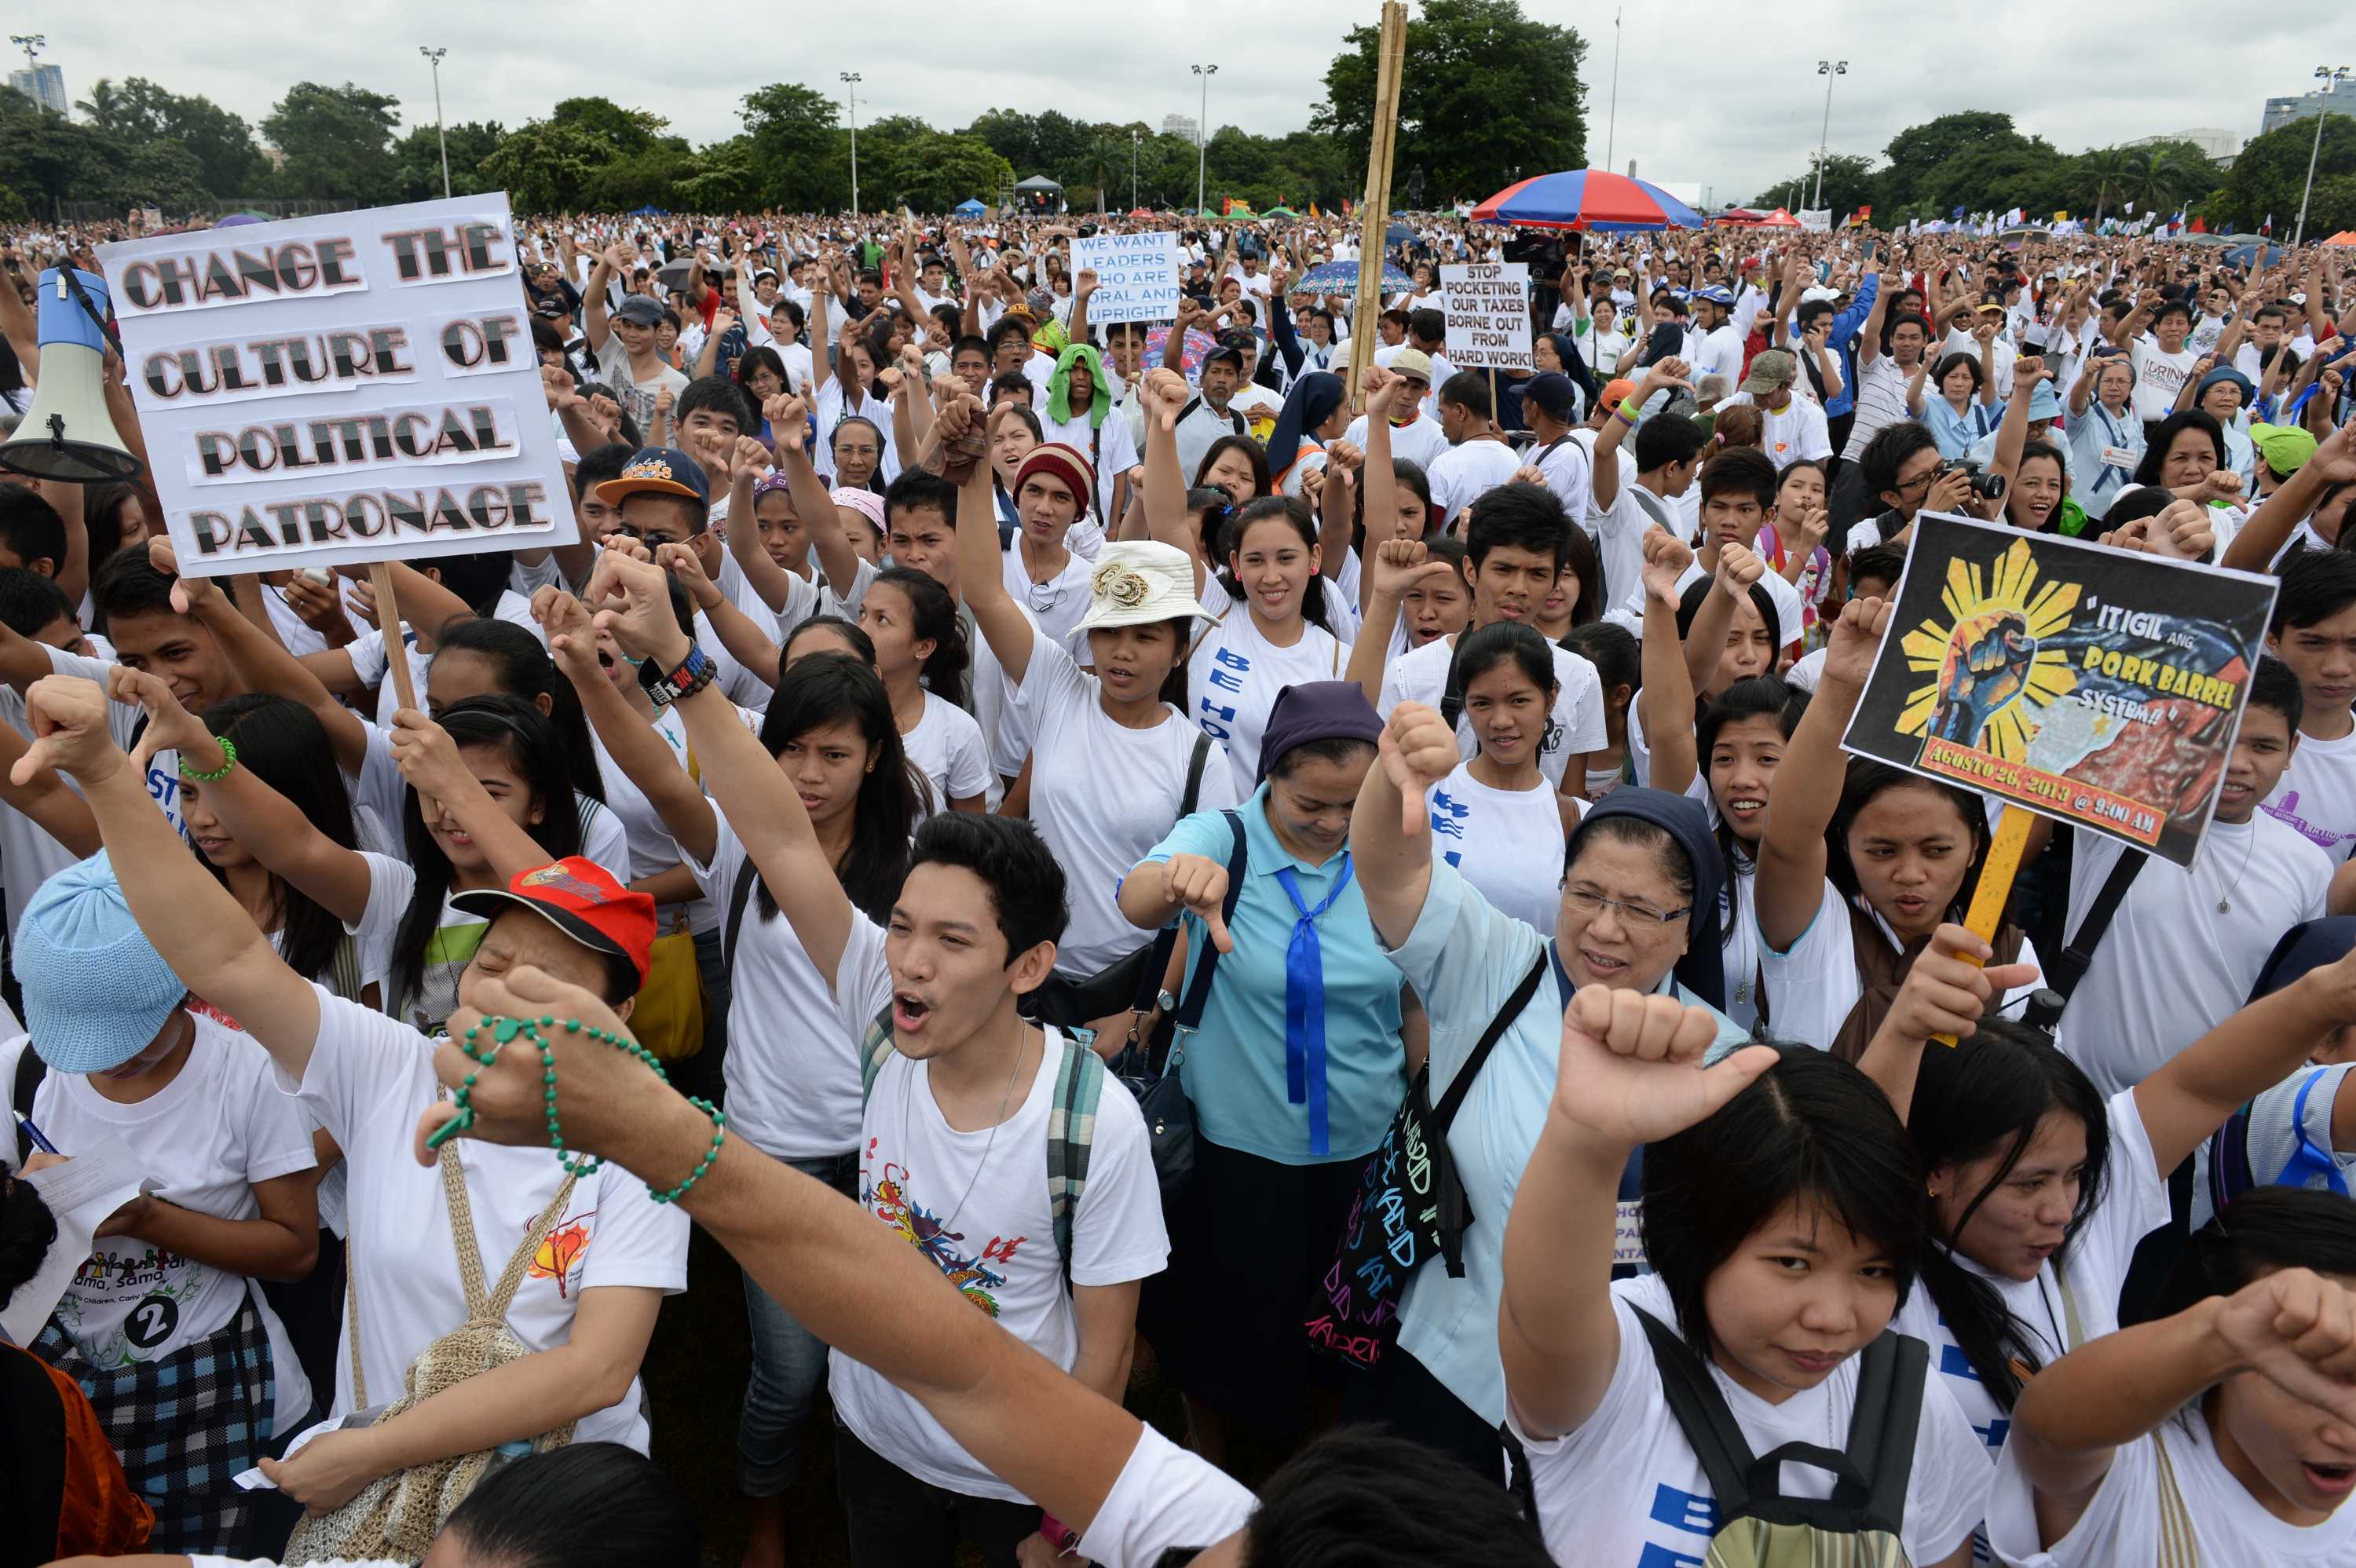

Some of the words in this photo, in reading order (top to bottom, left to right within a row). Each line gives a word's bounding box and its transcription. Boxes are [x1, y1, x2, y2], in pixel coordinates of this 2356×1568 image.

[1080, 238, 1107, 251] WE
[1112, 234, 1167, 249] WANT
[123, 238, 360, 308] CHANGE
[382, 221, 508, 280] THE
[1083, 253, 1165, 269] LEADERS
[1101, 273, 1125, 285] HO
[1132, 271, 1169, 283] ARE
[1467, 265, 1501, 279] STOP
[1089, 291, 1133, 305] ORAL
[1142, 287, 1179, 302] AND
[1445, 282, 1521, 295] POCKETING
[1089, 305, 1169, 322] UPRIGHT
[1452, 298, 1478, 312] OUR
[1481, 298, 1524, 313] TAXES
[1447, 314, 1491, 330] BORNE
[1495, 317, 1523, 331] OUT
[1472, 332, 1509, 347] FROM
[144, 328, 412, 398] CULTURE
[441, 316, 519, 368] OF
[1448, 349, 1483, 363] HARD
[1487, 351, 1531, 367] WORK!
[196, 407, 512, 477] POLITICAL
[190, 483, 549, 554] PATRONAGE
[2166, 632, 2195, 649] ANG
[2083, 645, 2160, 687] PORK
[2157, 664, 2237, 711] BARREL
[1929, 745, 1992, 778] AGOSTO
[1996, 766, 2021, 790] 26,
[2026, 776, 2071, 803] 2013
[2072, 795, 2091, 812] @
[2094, 797, 2130, 822] 9:00
[2130, 813, 2156, 834] AM
[72, 1277, 111, 1292] ama,
[137, 1303, 167, 1342] 2
